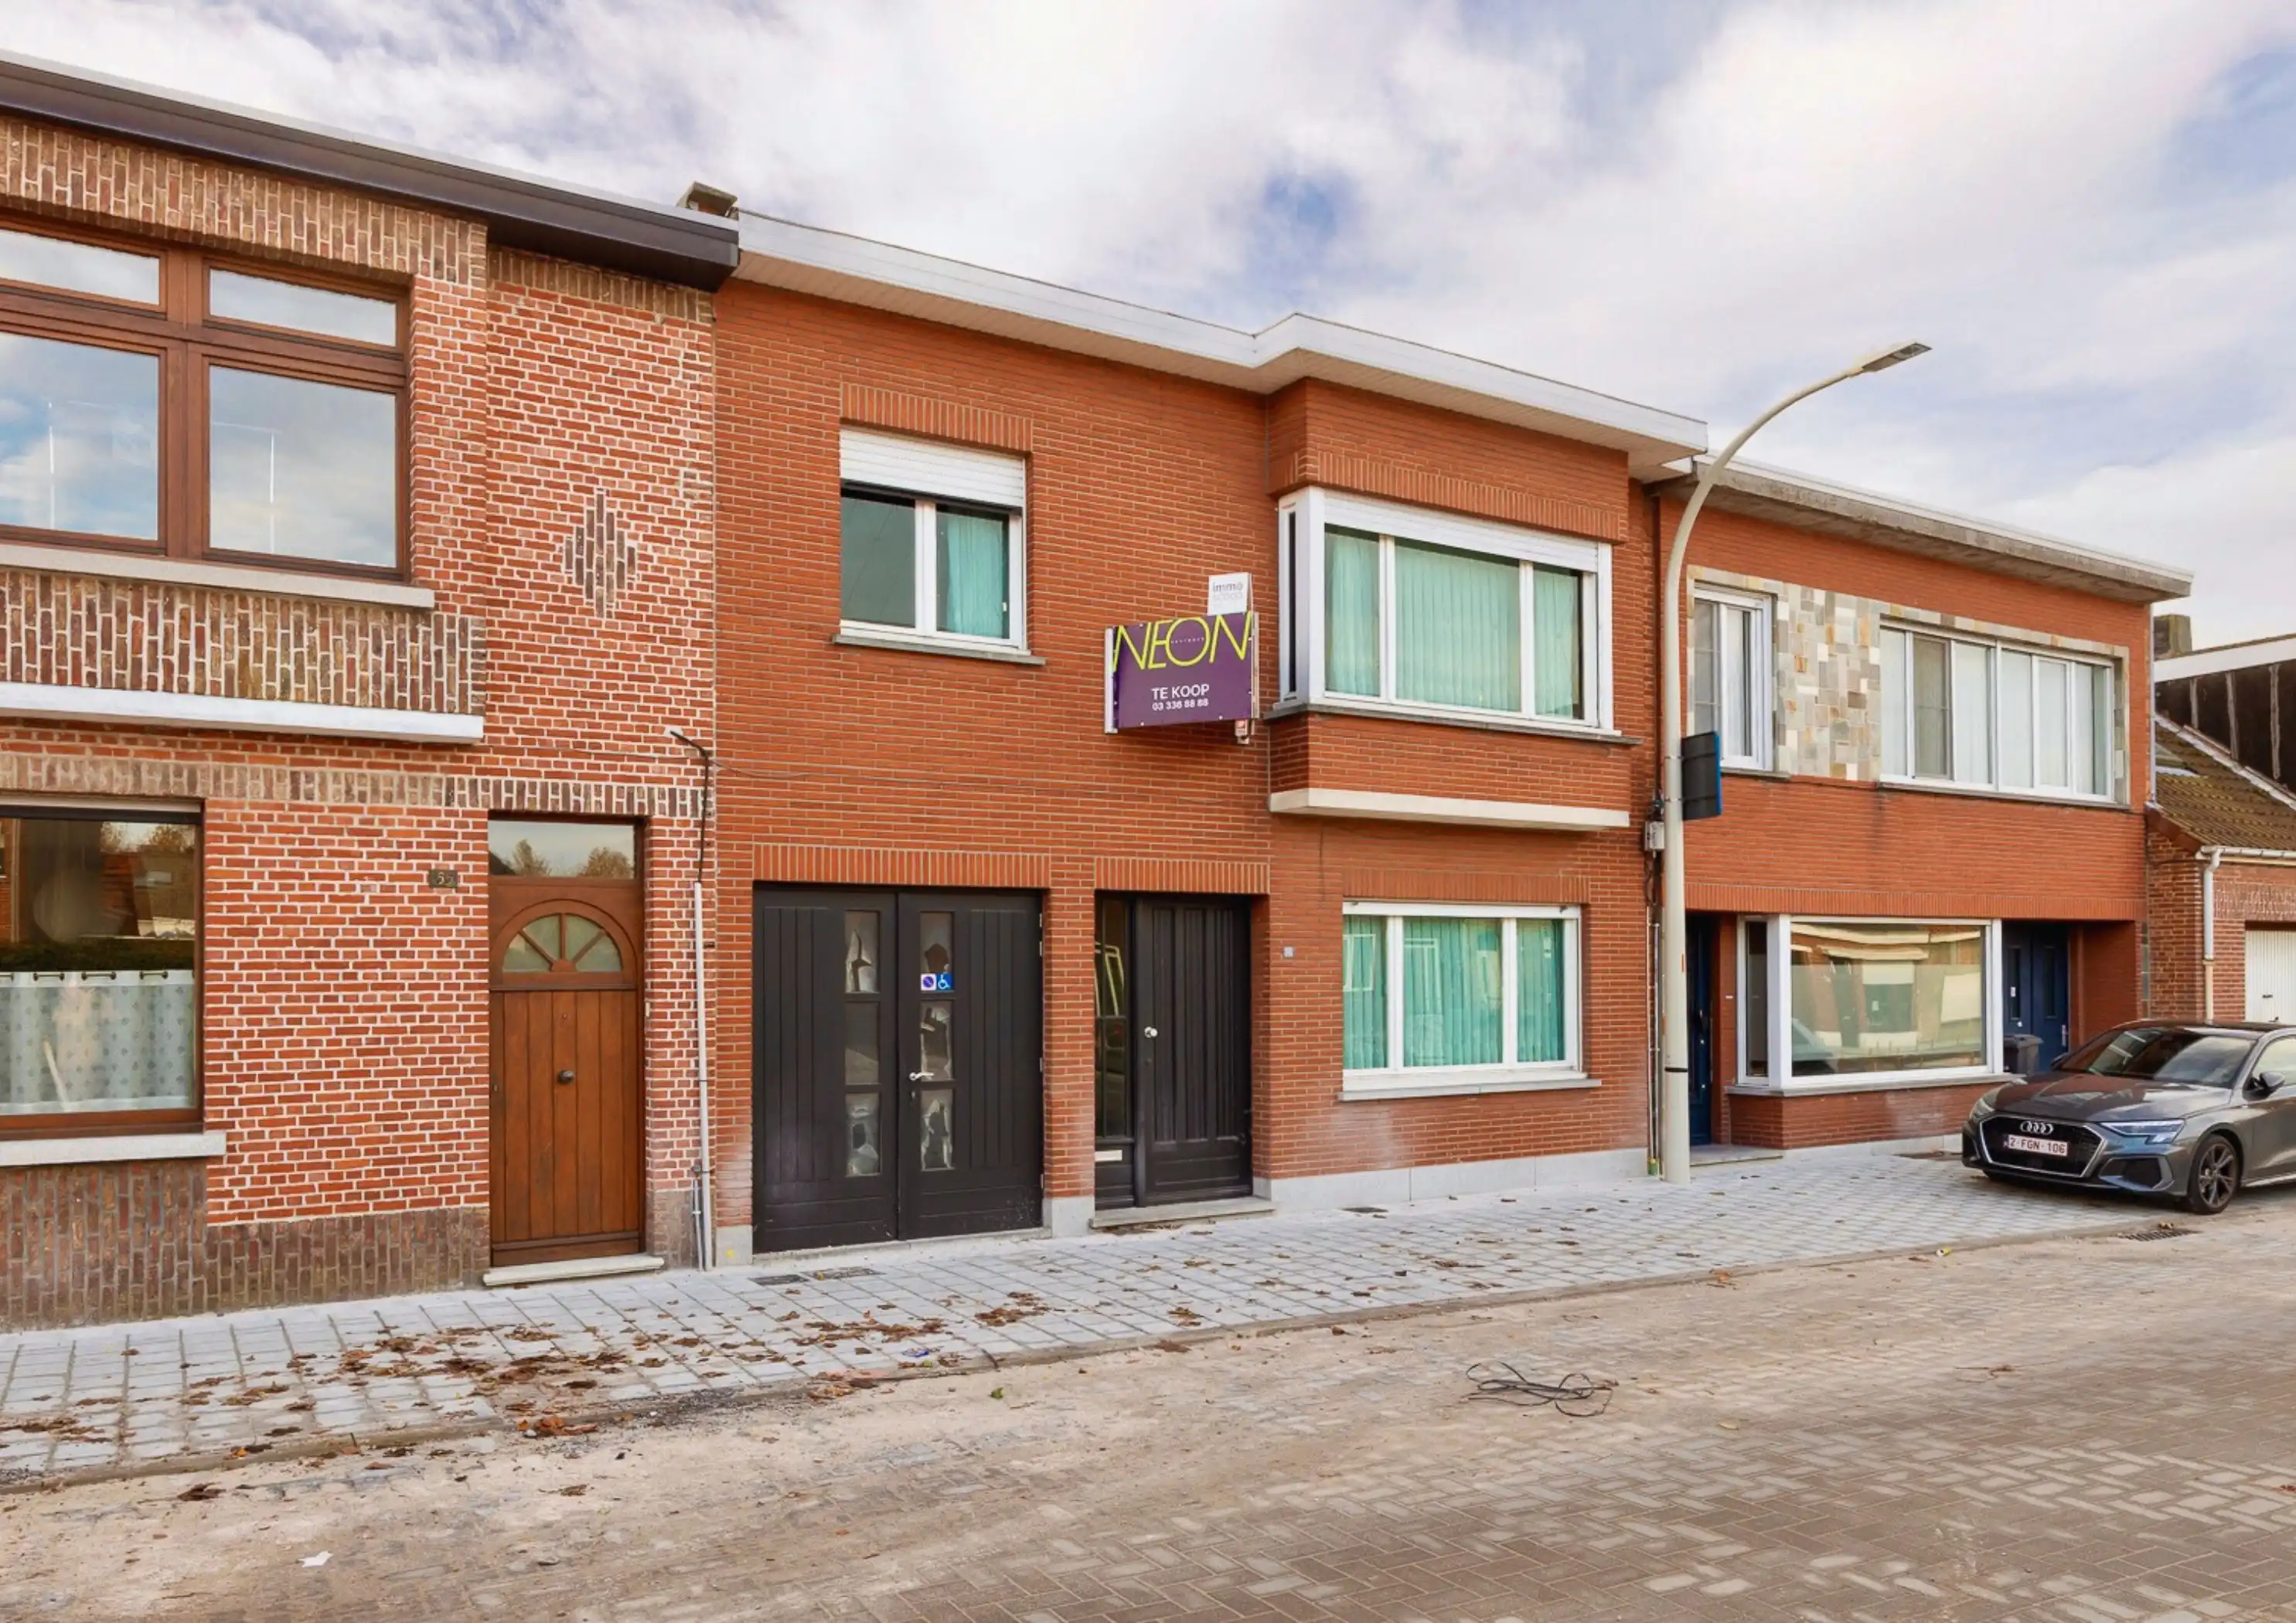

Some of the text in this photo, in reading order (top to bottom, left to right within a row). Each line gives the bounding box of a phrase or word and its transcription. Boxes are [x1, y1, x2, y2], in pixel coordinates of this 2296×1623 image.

[1112, 611, 1253, 672] NEON
[1151, 683, 1209, 700] TE KOOP
